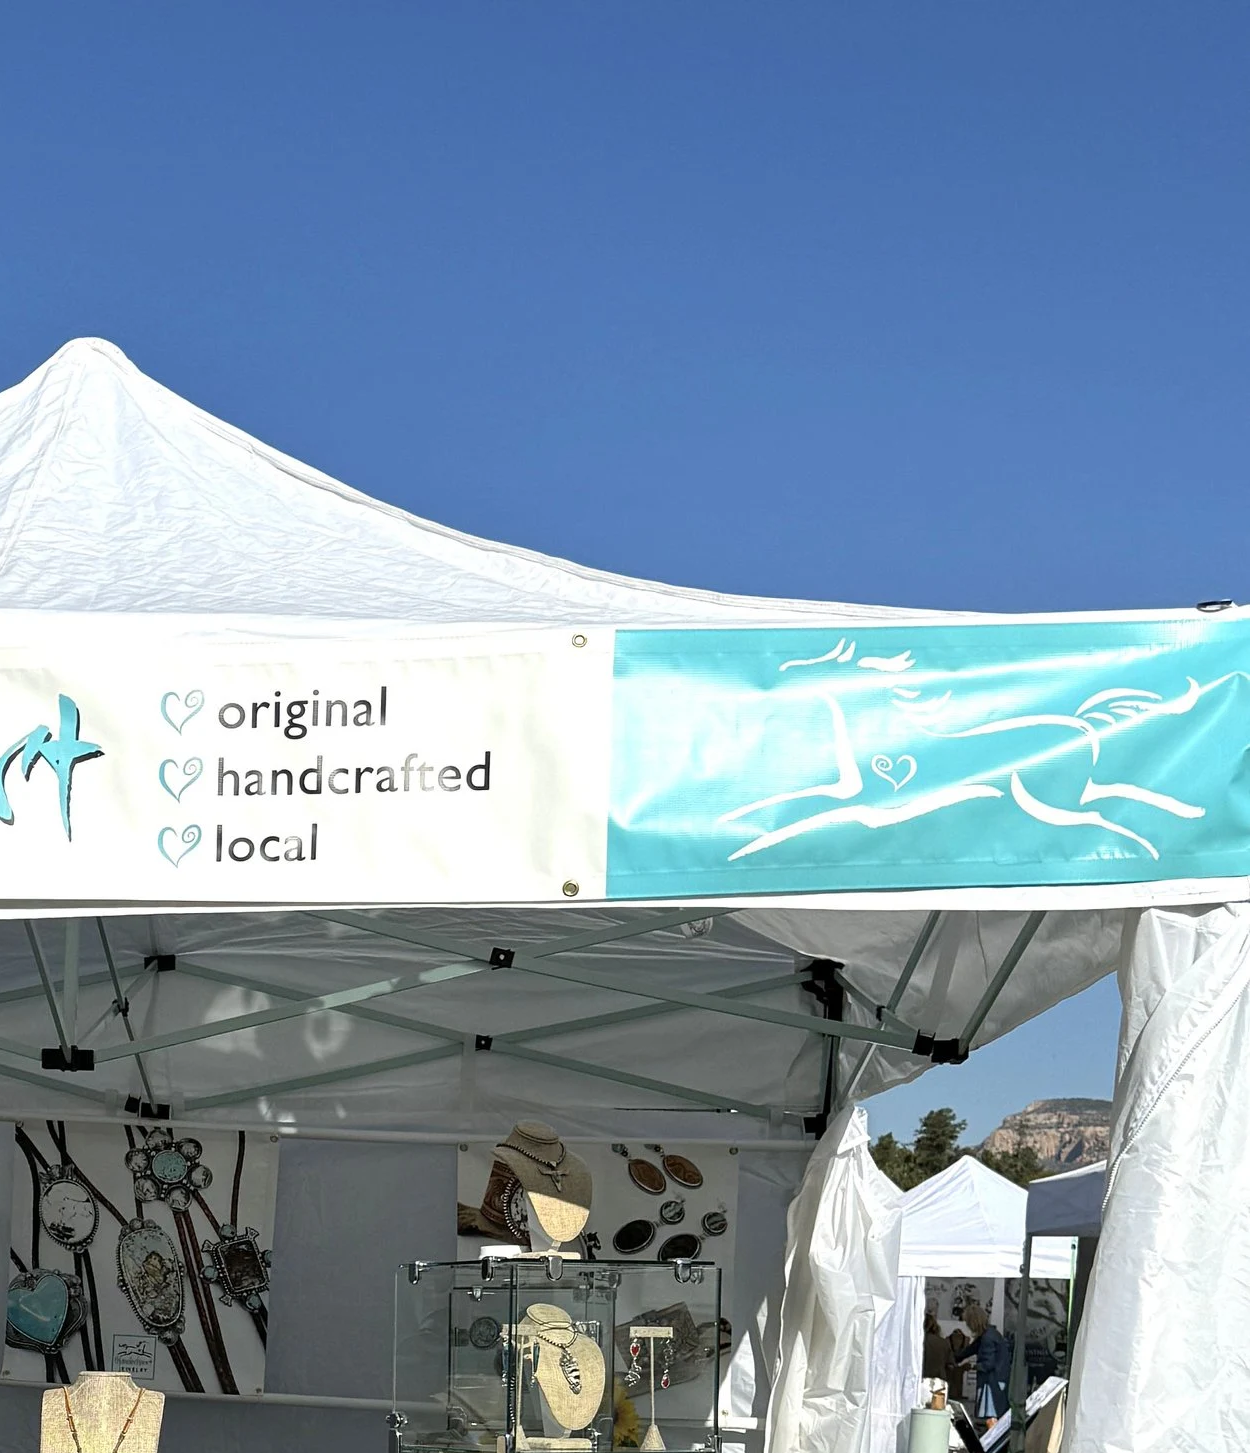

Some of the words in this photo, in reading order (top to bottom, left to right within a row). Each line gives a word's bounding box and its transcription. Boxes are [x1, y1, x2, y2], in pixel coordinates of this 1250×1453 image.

[217, 685, 388, 740] original
[217, 750, 492, 796] handcrafted
[215, 823, 318, 862] local
